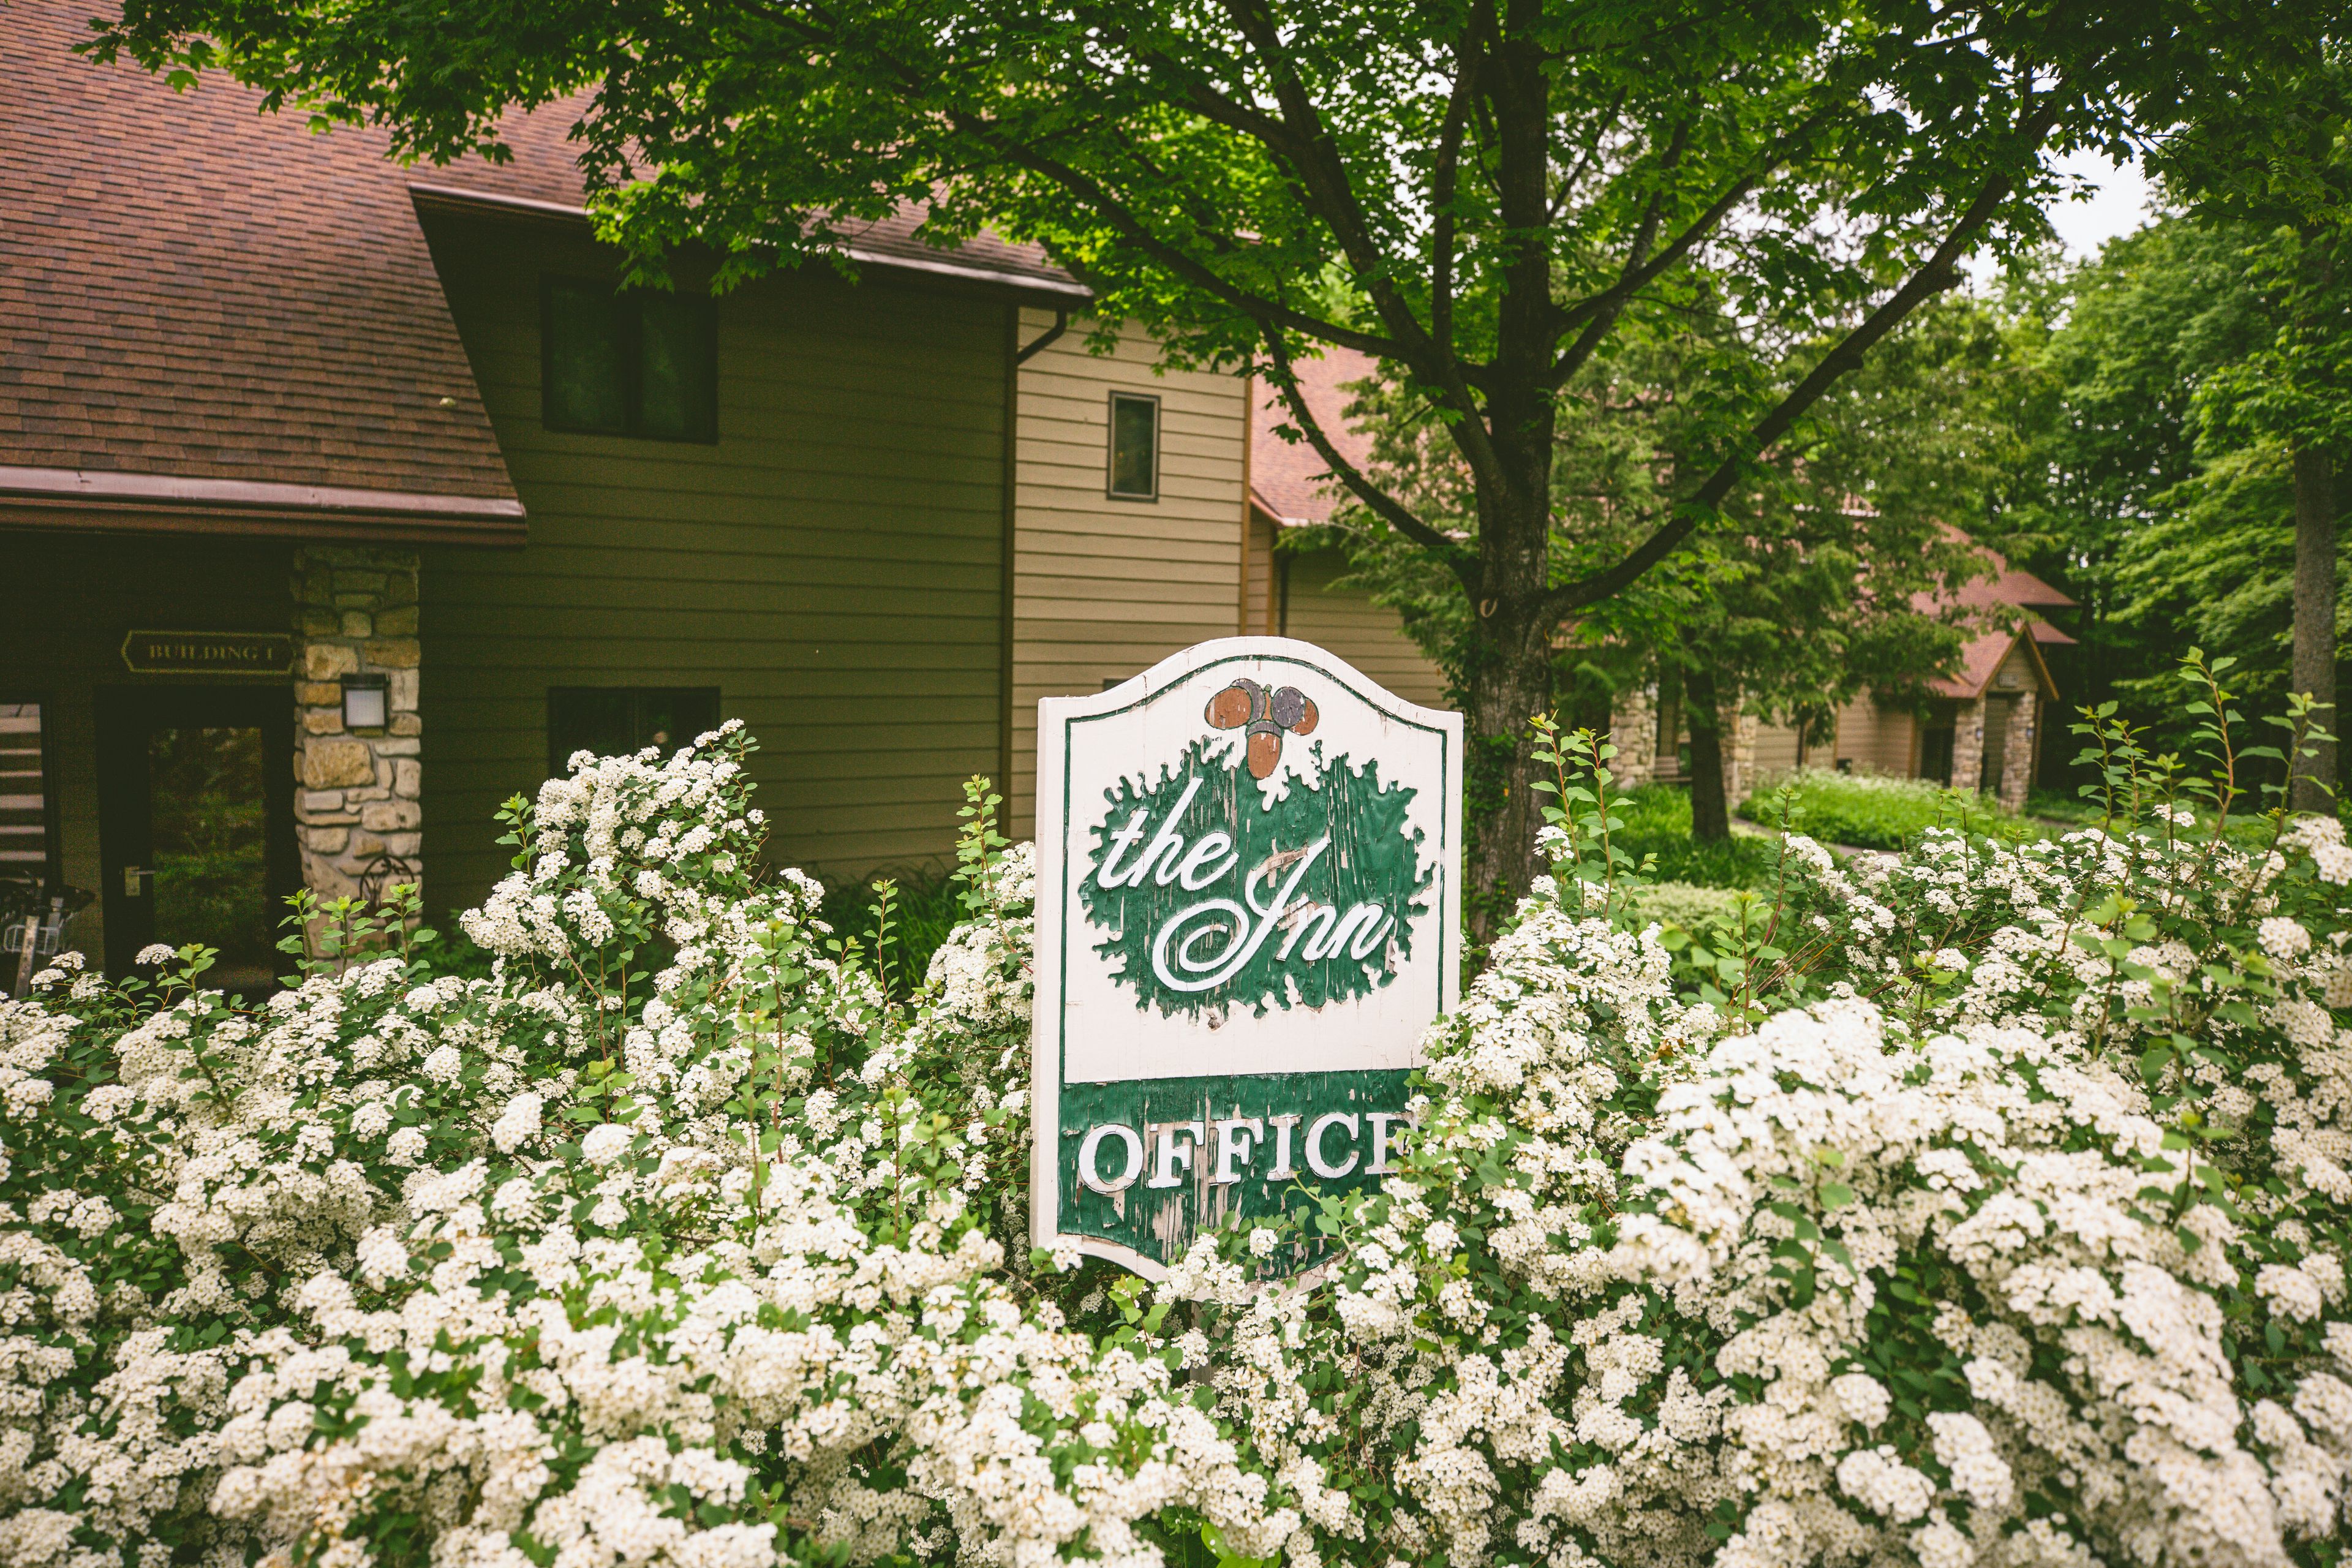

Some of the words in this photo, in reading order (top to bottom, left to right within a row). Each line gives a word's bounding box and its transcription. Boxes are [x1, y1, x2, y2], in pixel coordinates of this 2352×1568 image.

[149, 644, 258, 660] BUILDING
[1097, 777, 1240, 891] the
[1152, 836, 1395, 993] Inn
[1078, 1112, 1419, 1194] OFFICE
